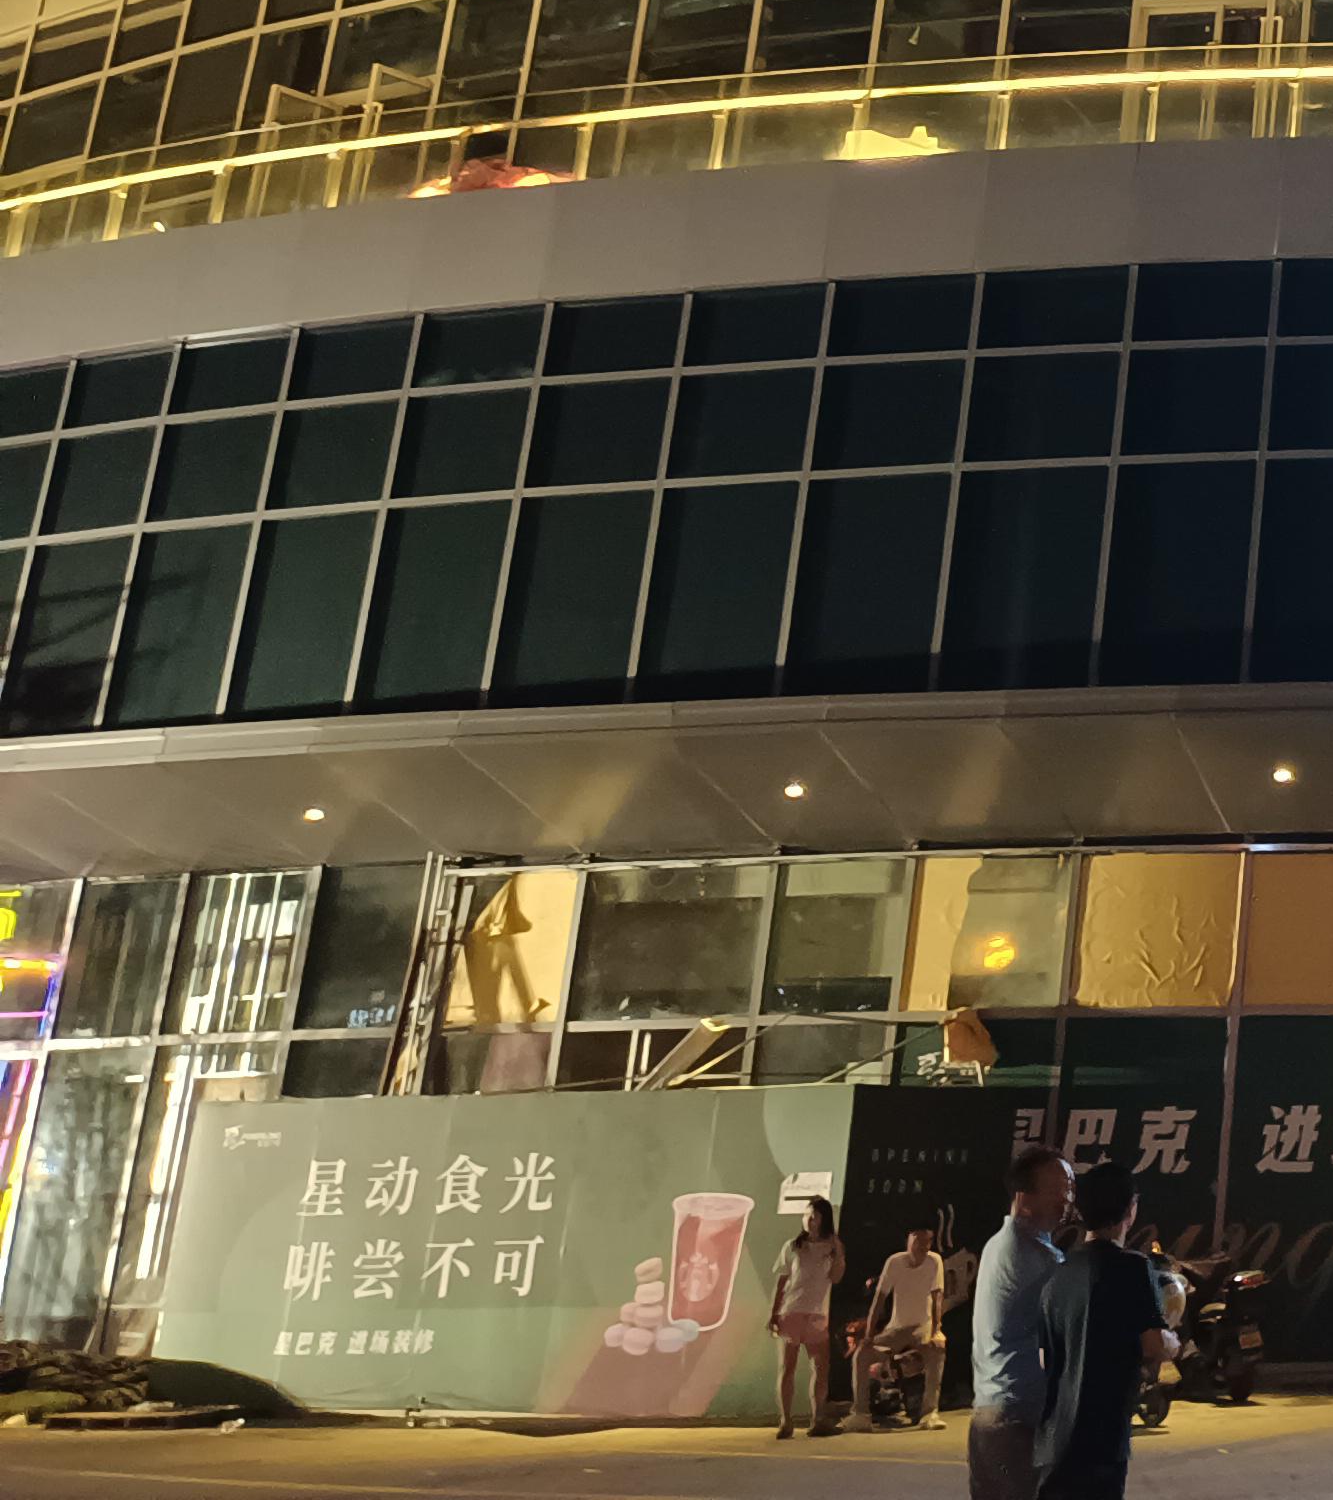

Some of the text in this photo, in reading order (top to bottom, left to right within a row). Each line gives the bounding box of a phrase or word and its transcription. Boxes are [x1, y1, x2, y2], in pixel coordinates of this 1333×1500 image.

[296, 1153, 556, 1216] 星动食光
[283, 1235, 545, 1301] 啡尝不可
[346, 1329, 435, 1355] 进场装修
